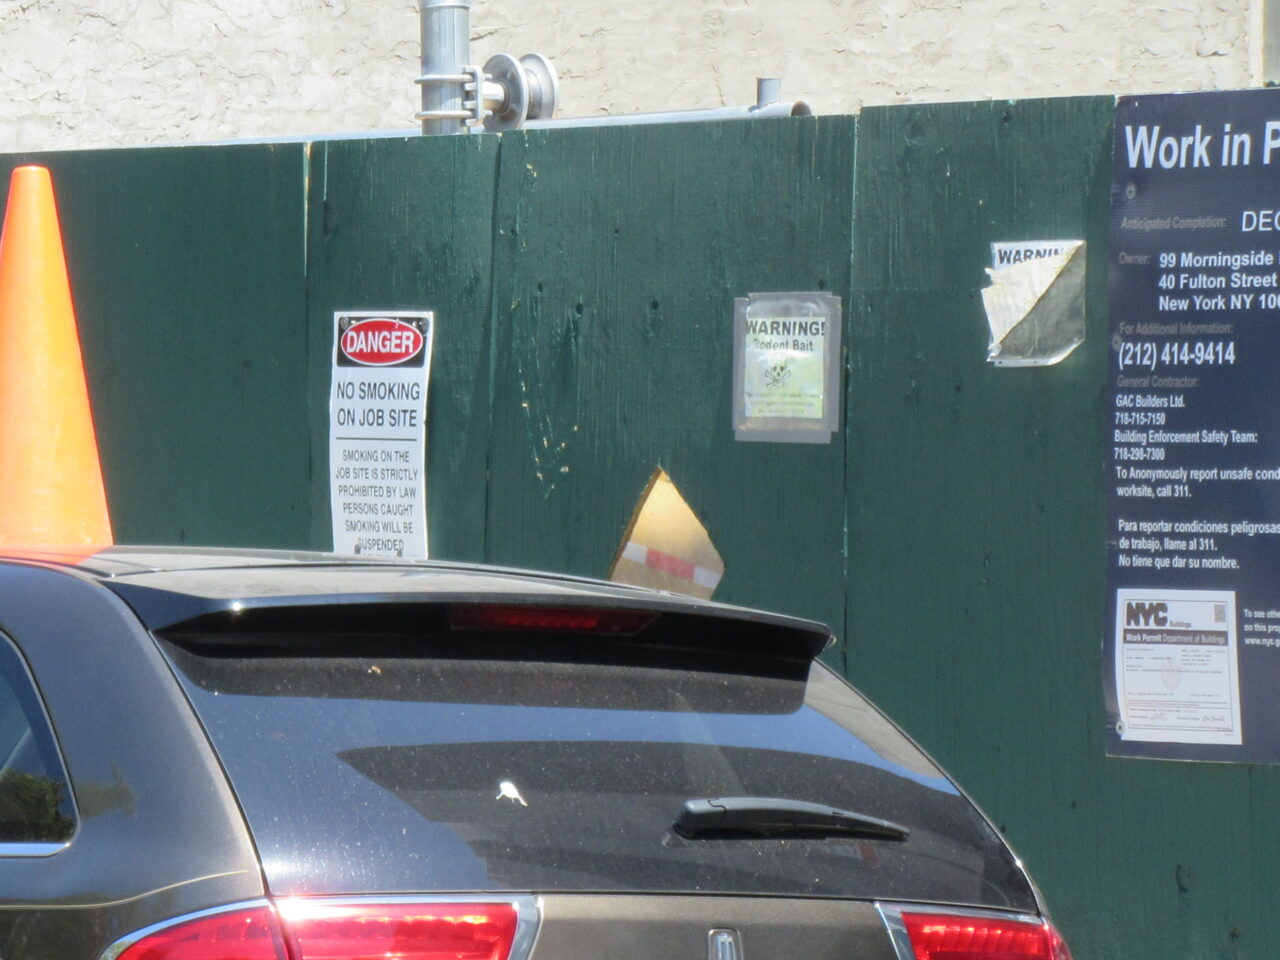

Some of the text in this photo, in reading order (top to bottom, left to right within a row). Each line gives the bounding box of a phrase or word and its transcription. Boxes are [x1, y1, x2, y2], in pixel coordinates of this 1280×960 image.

[1124, 124, 1212, 168] Work
[1221, 123, 1251, 166] in
[1120, 217, 1170, 231] Anticipated
[1172, 216, 1227, 231] Completion:
[997, 248, 1063, 264] WARNI
[1158, 253, 1176, 268] 99
[1180, 250, 1274, 270] Morningside
[1158, 272, 1278, 289] 40 Fulton Street
[1159, 296, 1189, 311] New
[1193, 294, 1226, 310] York
[1230, 294, 1254, 310] NY
[746, 321, 825, 336] WARNING!
[1136, 322, 1178, 335] Additional
[1179, 321, 1234, 335] Information:
[346, 331, 415, 353] DANGER
[792, 339, 814, 352] Bait
[1118, 341, 1236, 371] (212) 414-9414
[1117, 375, 1150, 388] General
[337, 382, 420, 400] NO SMOKING
[1115, 394, 1186, 408] GAC Builders Ltd.
[337, 408, 417, 427] ON JOB SITE
[1115, 411, 1166, 425] 718-715-7150
[1114, 430, 1258, 446] Building Enforcement Safety Team:
[342, 449, 410, 463] SMOKING ON THE
[335, 467, 418, 480] JOB SITE IS STRICTLY
[1116, 466, 1127, 479] To
[1129, 467, 1187, 482] Anonymously
[1190, 468, 1218, 482] report
[1220, 467, 1253, 480] unsafe
[338, 485, 416, 498] PROHIBITED BY LAW
[1116, 485, 1192, 498] worksite, call 311.
[343, 502, 413, 516] PERSONS CAUGHT
[345, 520, 413, 534] SMOKING WILL BE
[1118, 519, 1280, 536] Para reportar condiciones peligrosas
[357, 538, 404, 551] SUSPENDED
[1119, 537, 1218, 552] de trabajo, llame al 311.
[1118, 554, 1240, 570] No tiene que dar su nombre.
[1126, 602, 1168, 627] NYC
